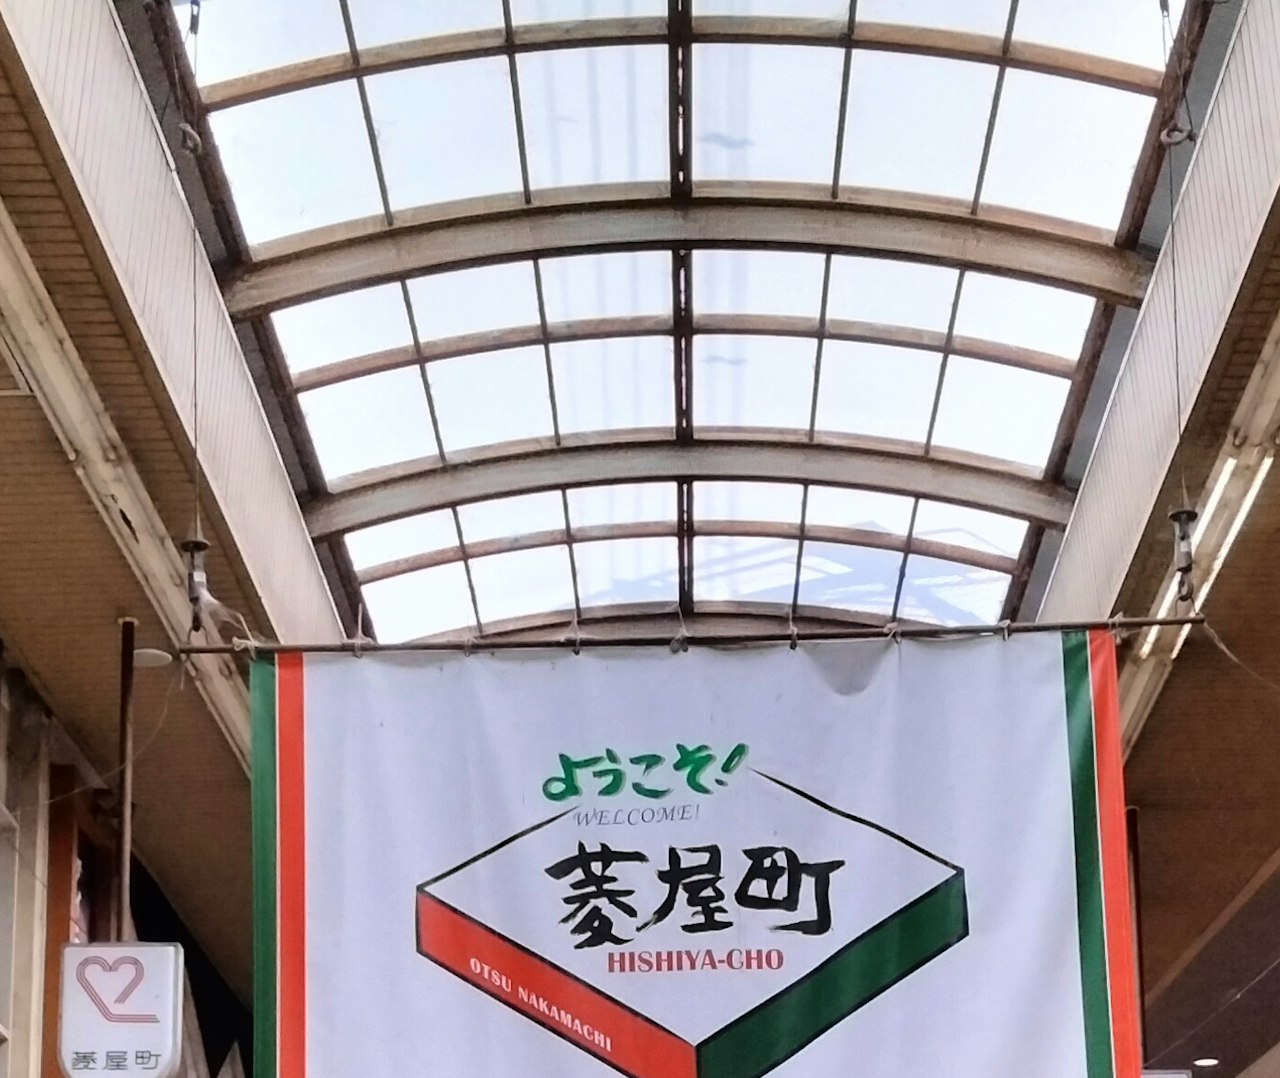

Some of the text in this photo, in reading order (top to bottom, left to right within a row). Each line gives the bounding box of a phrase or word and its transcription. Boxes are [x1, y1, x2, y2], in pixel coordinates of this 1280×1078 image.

[573, 803, 701, 829] WELCOME!
[543, 840, 846, 949] 菱屋町
[607, 948, 785, 974] HISHIYA-CHO
[468, 956, 614, 1053] OTSU NAKAMACHI
[71, 1050, 163, 1071] 菱屋町
